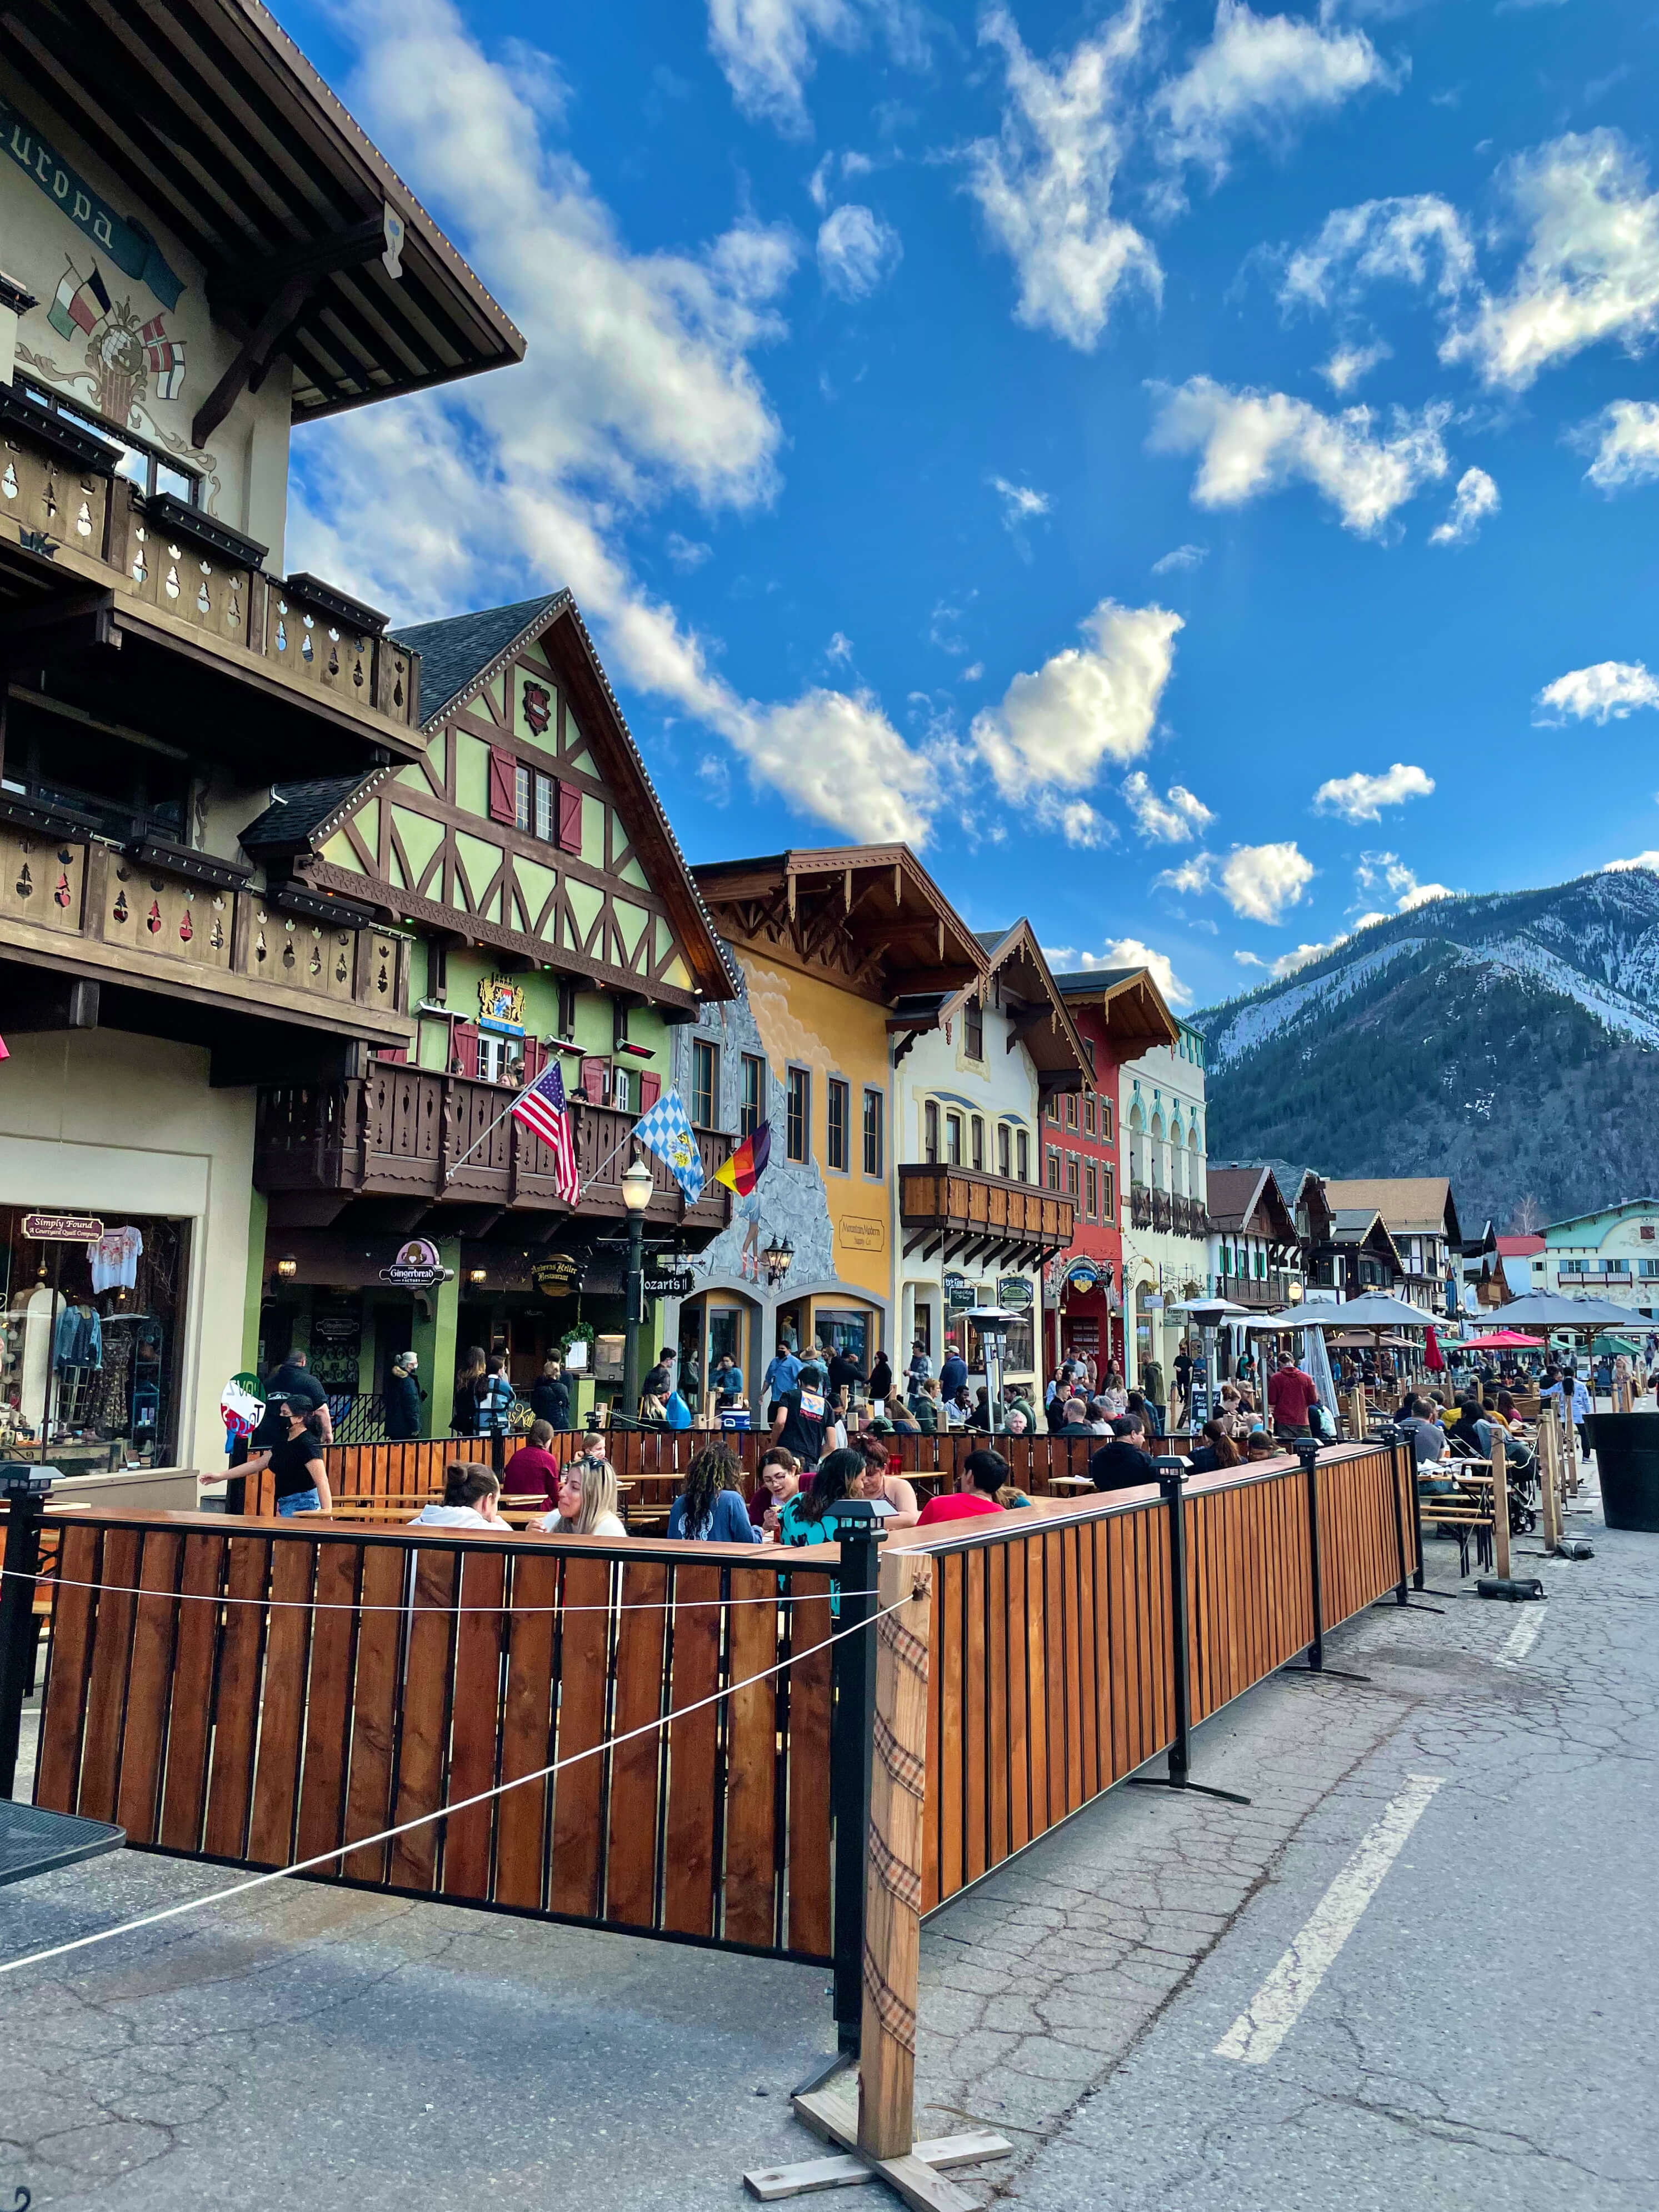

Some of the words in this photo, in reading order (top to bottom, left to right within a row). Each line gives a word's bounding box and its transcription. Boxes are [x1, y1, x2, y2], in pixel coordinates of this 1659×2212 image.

[0, 106, 113, 249] uropa
[34, 1218, 64, 1229] Simply
[66, 1220, 93, 1229] Found
[390, 1269, 433, 1279] Gingerbread
[556, 1262, 577, 1275] Keller
